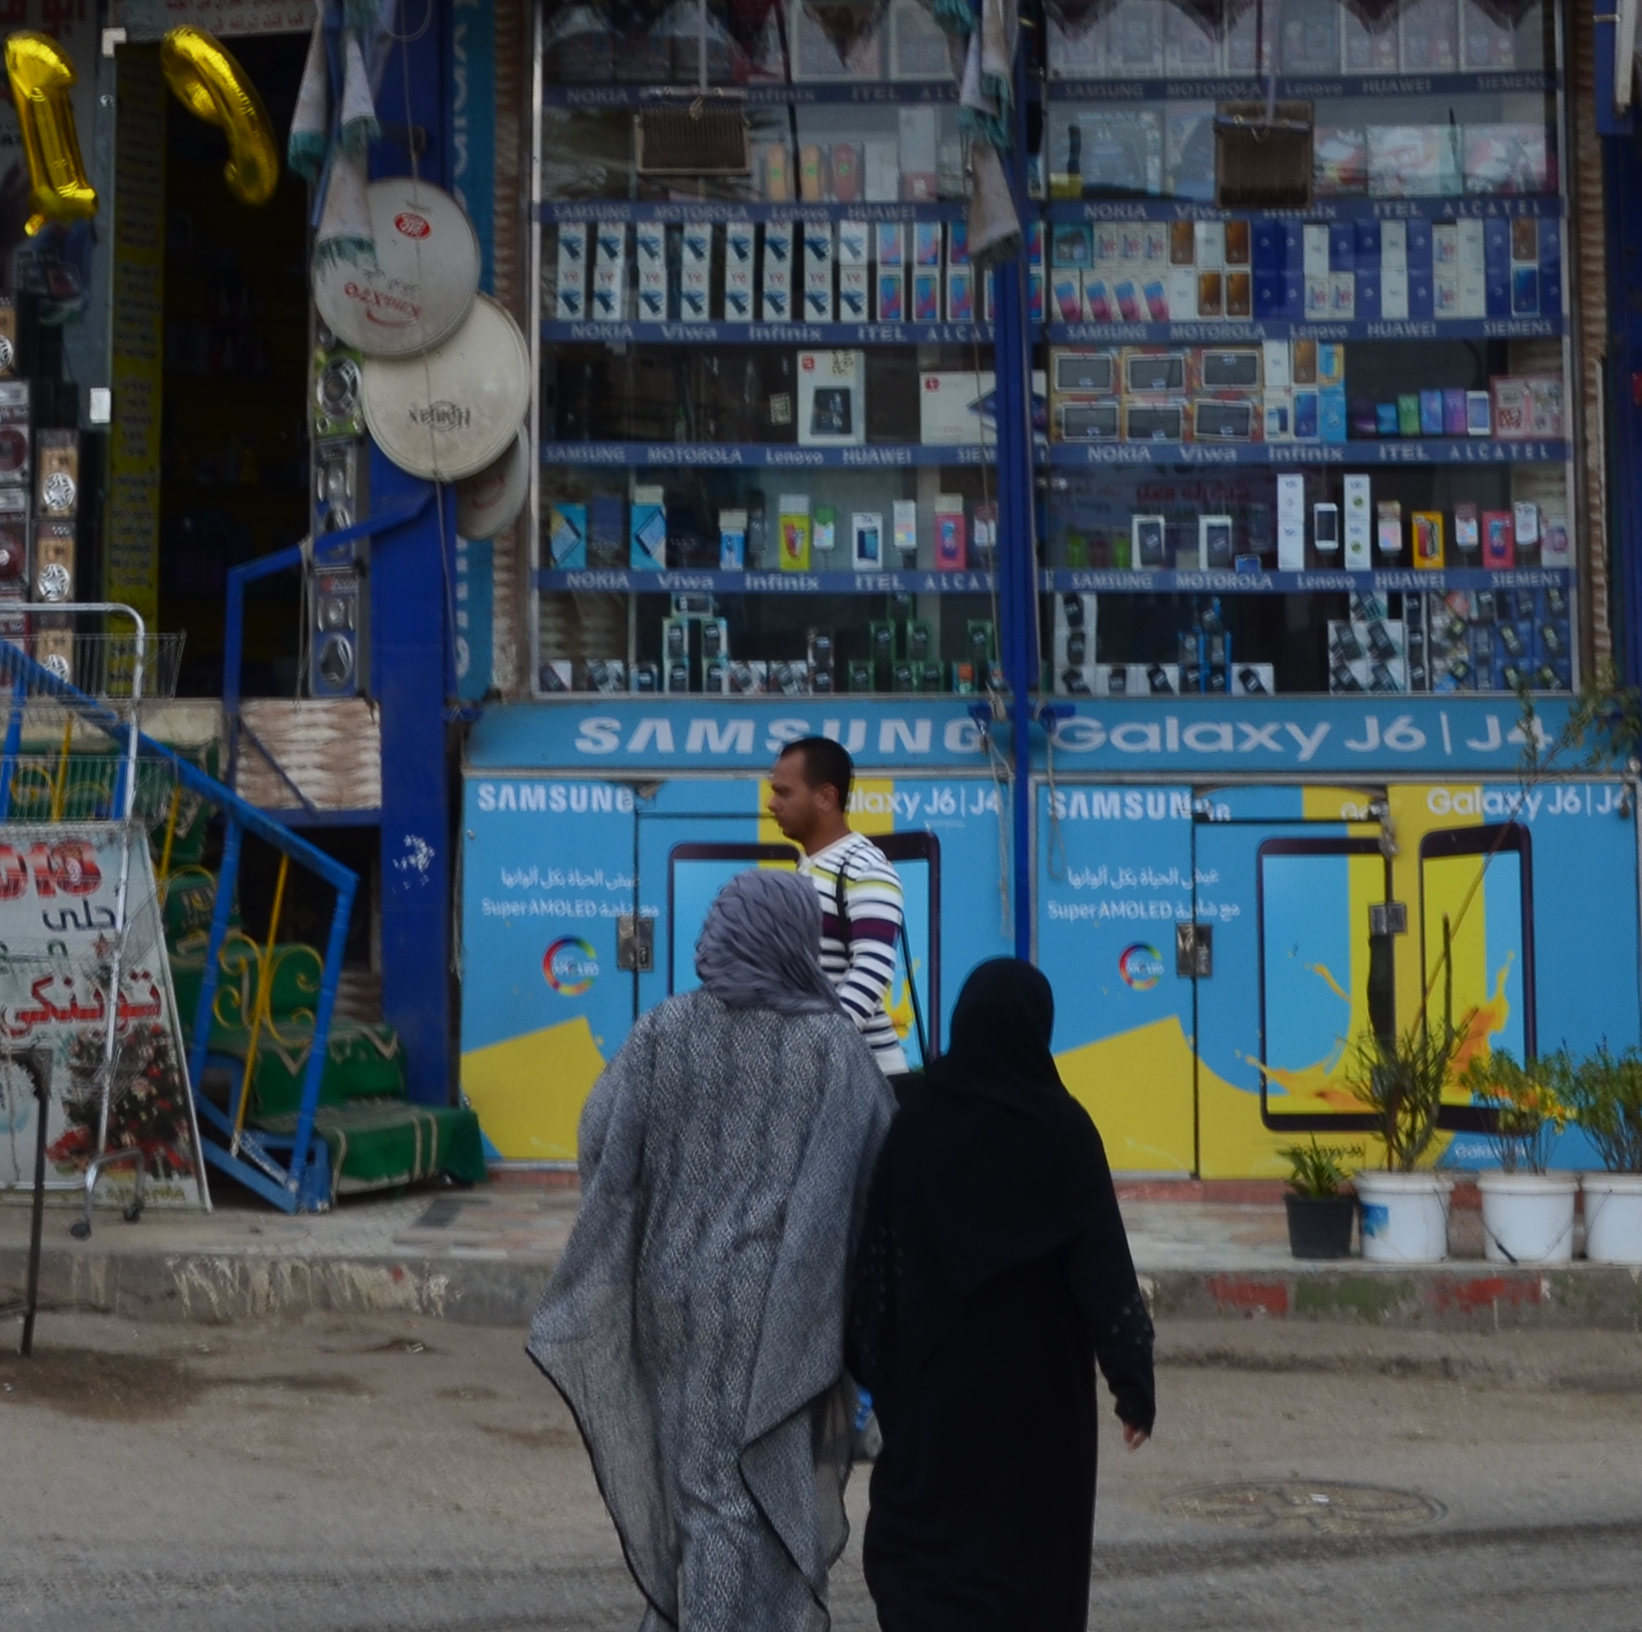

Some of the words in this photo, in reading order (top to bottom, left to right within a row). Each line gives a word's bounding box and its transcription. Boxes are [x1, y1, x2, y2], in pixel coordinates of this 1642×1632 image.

[565, 88, 630, 105] NOKIA
[1062, 82, 1145, 99] SAMSUNG
[1165, 81, 1262, 98] MOTOROLA
[1284, 79, 1344, 97] Lenovo
[1361, 78, 1432, 96] HUAWEI
[1475, 74, 1547, 92] SIEMENS
[550, 204, 633, 221] SAMSUNG
[651, 203, 749, 221] MOTOROLA
[770, 205, 829, 221] Lenovo
[847, 204, 917, 221] HUAWEI
[1083, 203, 1148, 220] NOKIA
[1372, 201, 1424, 218] ITEL
[1442, 200, 1542, 217] ALCATEL
[569, 323, 635, 340] NOKIA
[747, 322, 823, 342] Infinix
[856, 323, 908, 342] ITEL
[925, 324, 995, 342] ALCA
[1066, 324, 1148, 341] SAMSUNG
[1169, 323, 1267, 341] MOTOROLA
[1289, 322, 1349, 340] Lenovo
[1366, 321, 1438, 339] HUAWEI
[1481, 319, 1554, 337] SIEMENS
[544, 446, 627, 465] SAMSUNG
[646, 446, 744, 465] MOTOROLA
[764, 447, 825, 466] Lenovo
[841, 447, 913, 466] HUAWEI
[1086, 445, 1152, 463] NOKIA
[1178, 445, 1239, 463] Viwa
[1267, 444, 1345, 463] Infinix
[1378, 443, 1431, 461] ITEL
[1449, 442, 1548, 461] ALCATEL
[565, 572, 630, 590] NOKIA
[656, 572, 715, 590] Viwa
[743, 572, 821, 591] Infinix
[855, 573, 907, 591] ITEL
[923, 573, 993, 590] ALCA
[1070, 572, 1154, 591] SAMSUNG
[1174, 572, 1274, 591] MOTOROLA
[1296, 572, 1357, 590] Lenovo
[1374, 571, 1446, 588] HUAWEI
[1490, 569, 1563, 587] SIEMENS
[1047, 713, 1331, 762] Galaxy
[1344, 714, 1428, 754] J6
[1465, 714, 1554, 753] J4
[476, 782, 636, 815] SAMSUNG
[1426, 786, 1544, 821] Galaxy
[1546, 787, 1581, 814] J6
[481, 896, 527, 919] Super
[529, 898, 597, 917] AMOLED
[1046, 899, 1098, 923] Super
[1098, 899, 1173, 919] AMOLED
